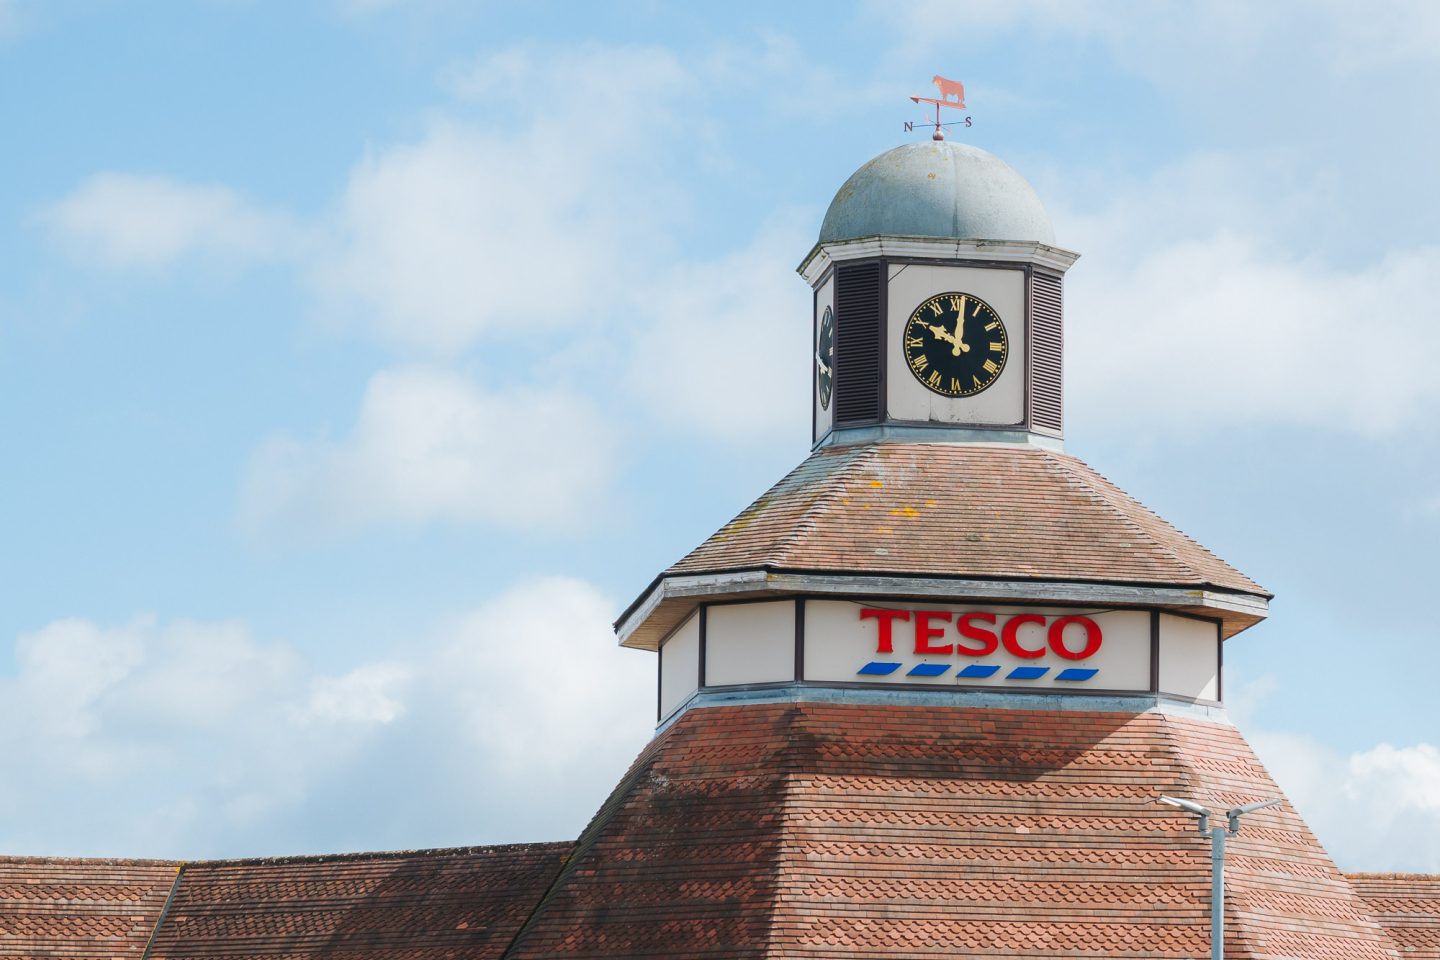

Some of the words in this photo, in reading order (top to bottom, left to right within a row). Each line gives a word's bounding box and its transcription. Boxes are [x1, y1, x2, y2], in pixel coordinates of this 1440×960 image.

[904, 122, 913, 132] N
[965, 116, 972, 128] S
[859, 608, 1103, 661] TESCO
